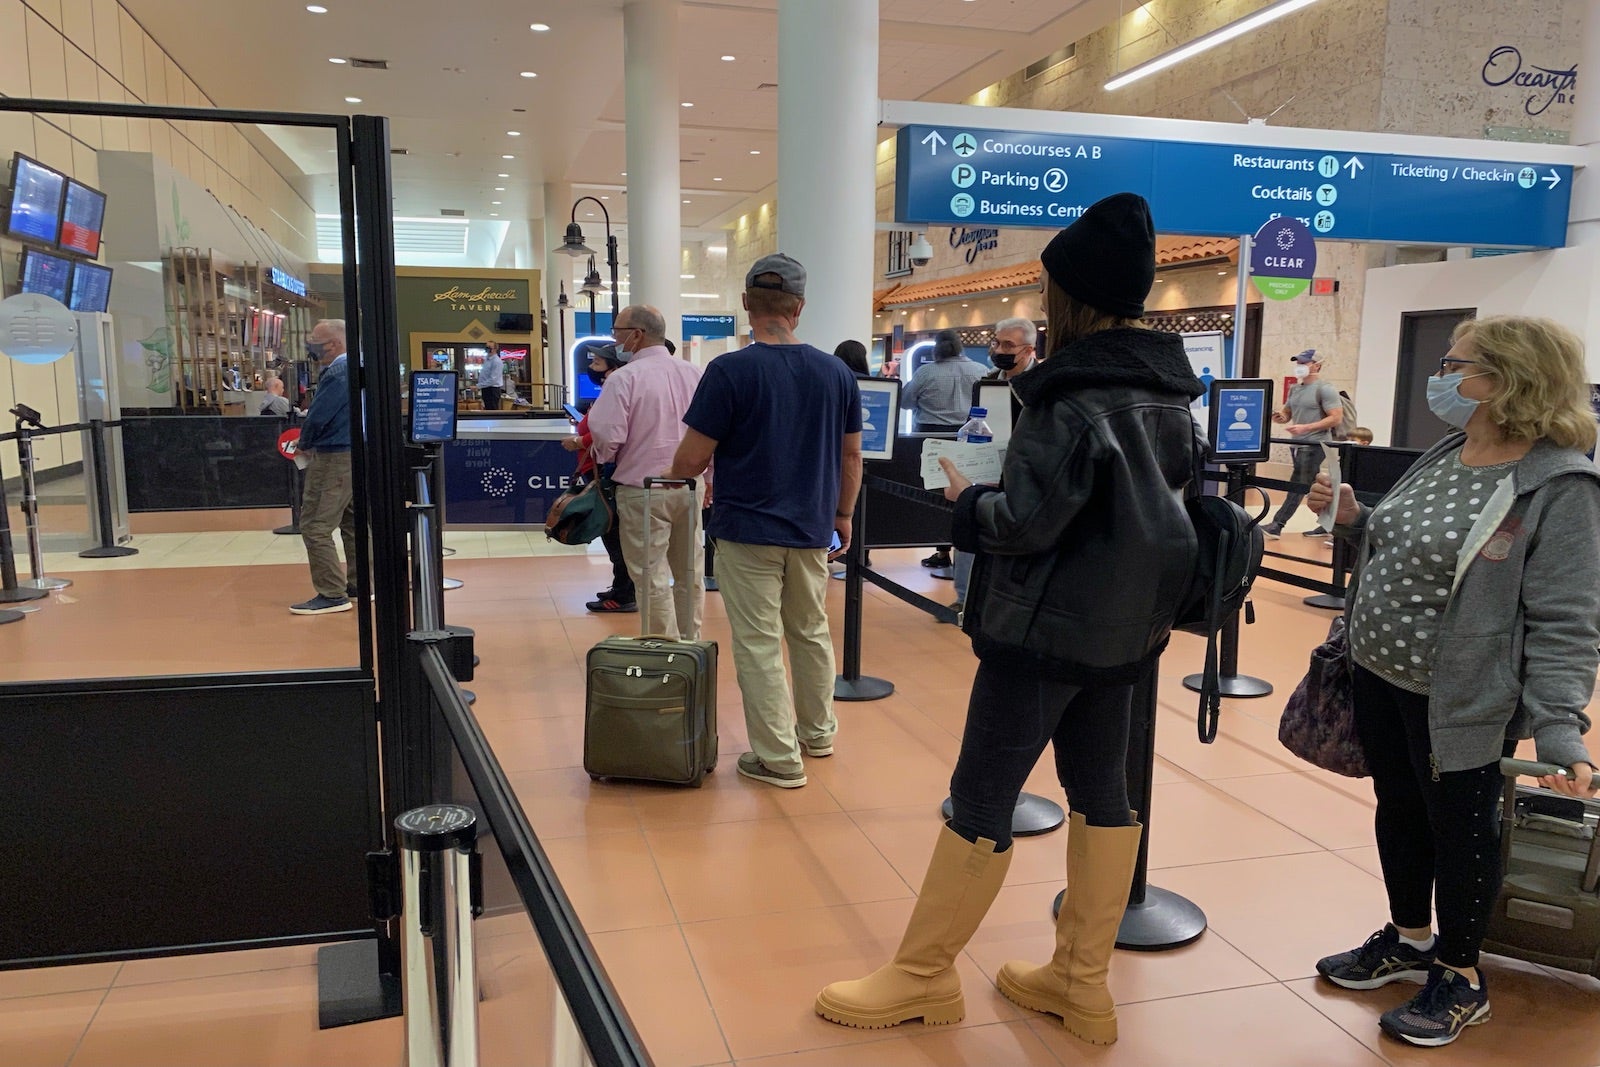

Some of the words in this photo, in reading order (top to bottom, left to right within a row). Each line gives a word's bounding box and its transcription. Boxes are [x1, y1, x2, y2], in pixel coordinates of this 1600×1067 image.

[983, 139, 1070, 158] Concourses
[1075, 145, 1088, 158] A
[1092, 146, 1102, 159] B
[1234, 154, 1314, 171] Restaurants
[982, 170, 1040, 190] Parking
[1391, 164, 1448, 182] Ticketing
[1462, 167, 1514, 182] Check-in
[1252, 185, 1312, 201] Cocktails
[980, 200, 1043, 216] Business
[1264, 256, 1304, 268] CLEAR
[450, 304, 500, 312] TAVERN
